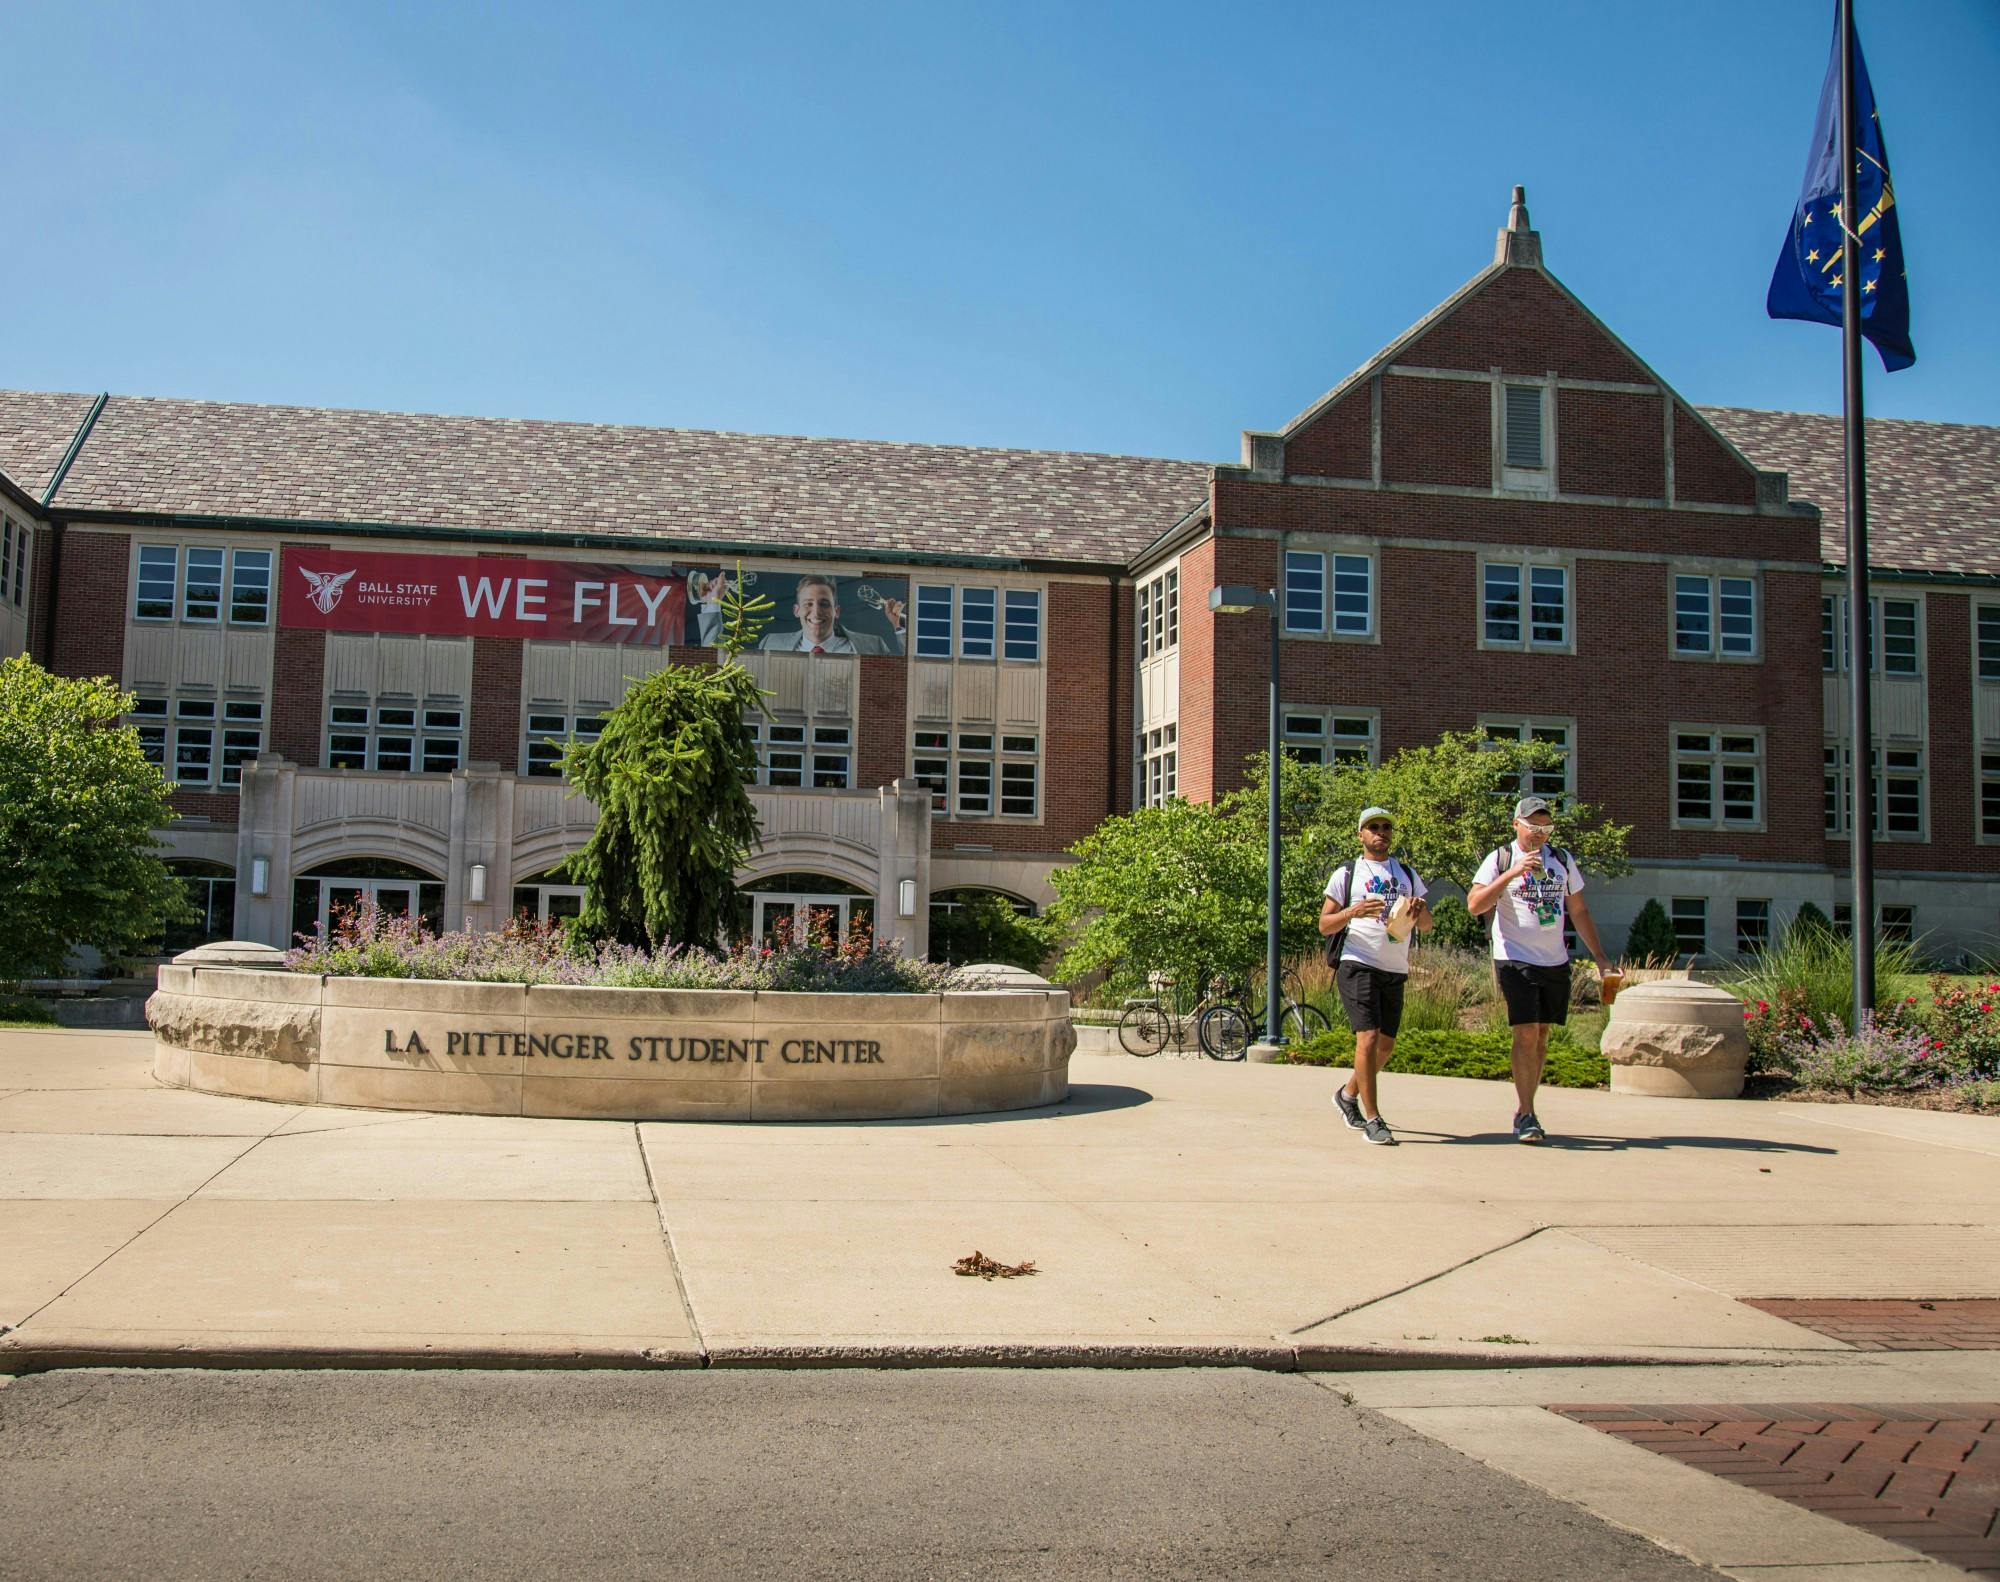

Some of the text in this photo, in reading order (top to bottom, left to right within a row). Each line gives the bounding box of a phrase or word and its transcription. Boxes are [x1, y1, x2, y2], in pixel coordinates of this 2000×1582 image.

[359, 582, 437, 595] BALL STATE
[358, 595, 431, 606] UNIVERSITY
[457, 575, 672, 627] WE FLY
[384, 1030, 884, 1063] L.A. PITTENGER STUDENT CENTER
